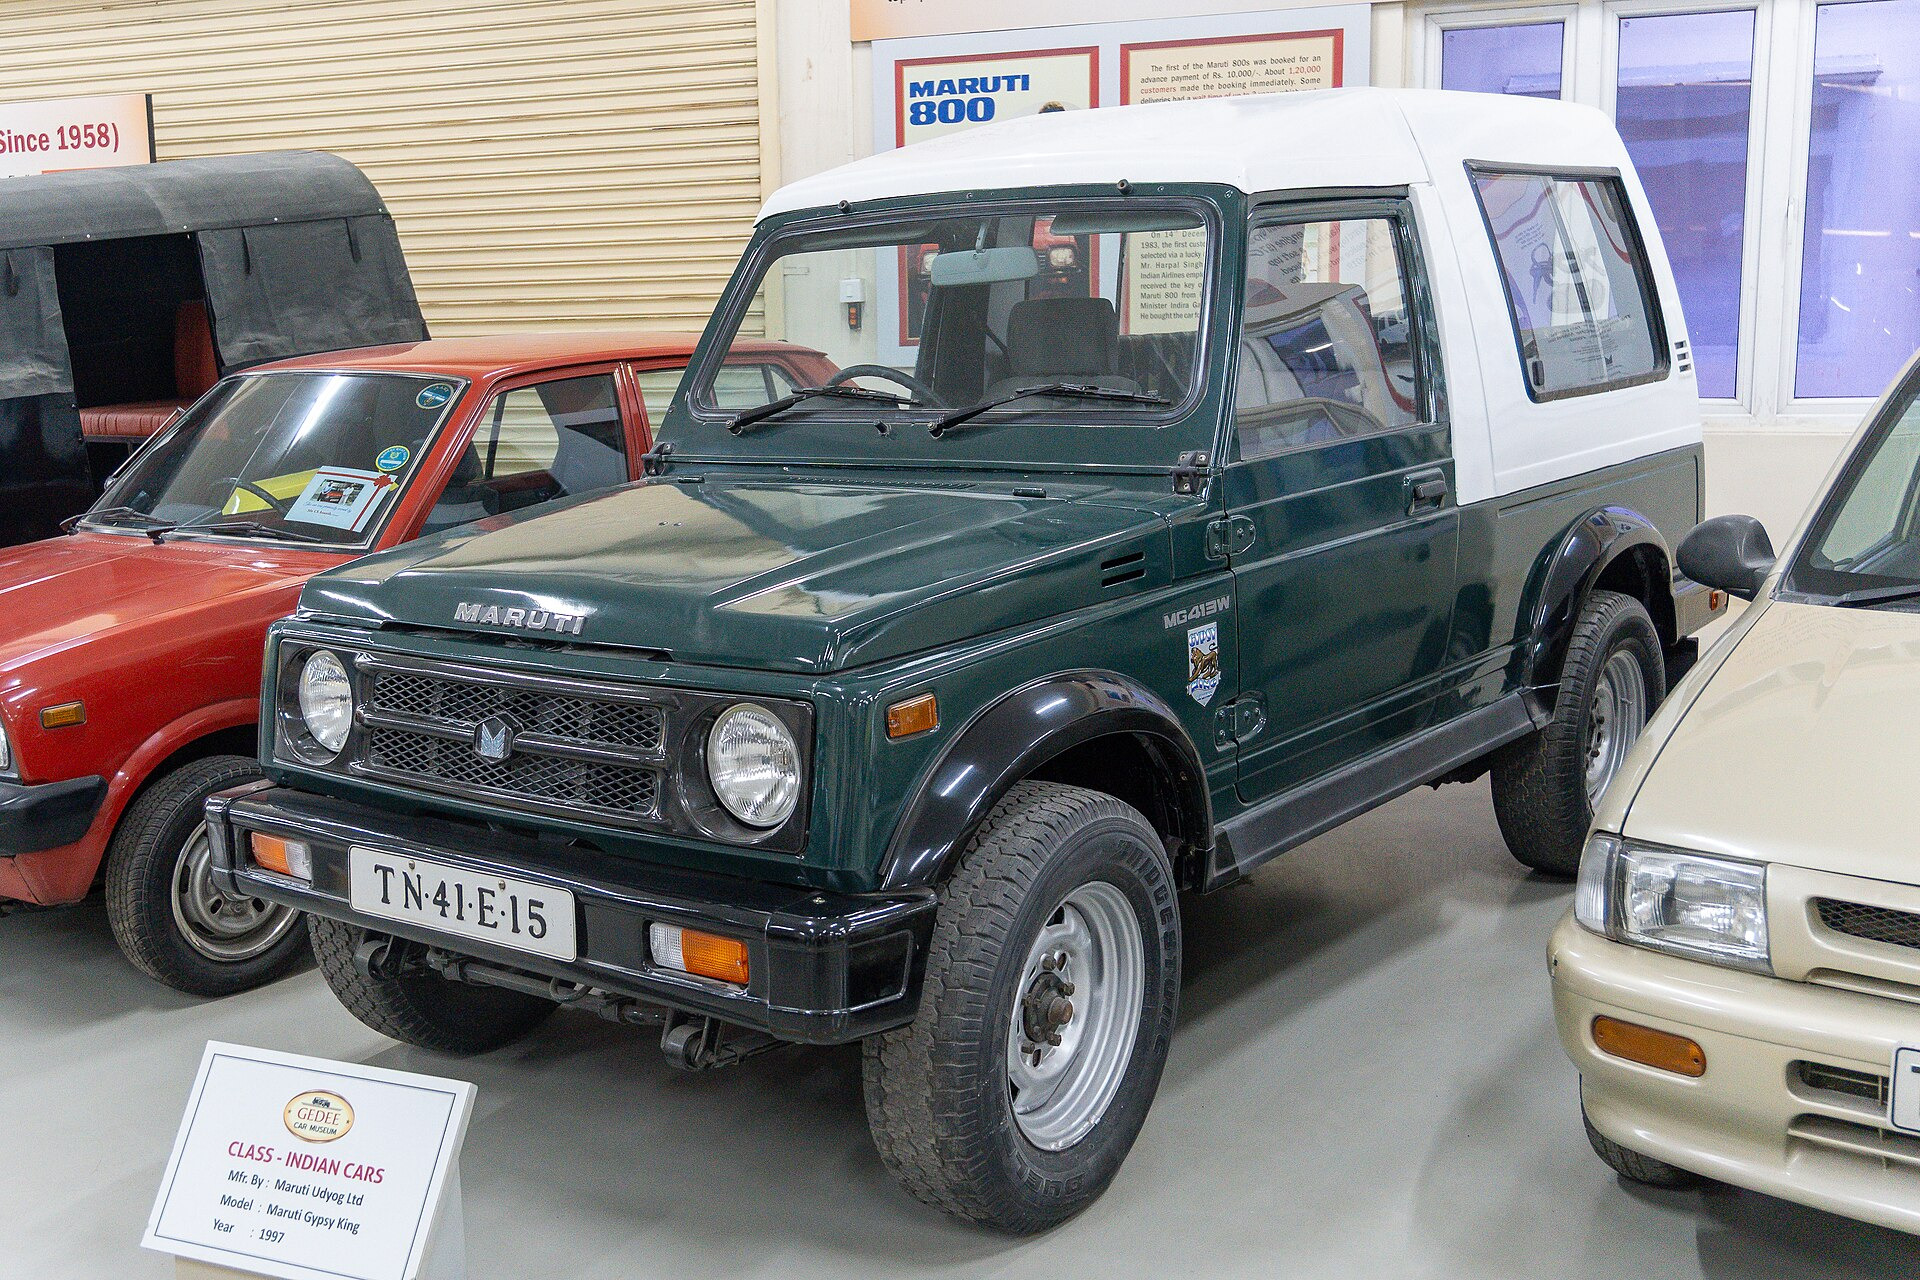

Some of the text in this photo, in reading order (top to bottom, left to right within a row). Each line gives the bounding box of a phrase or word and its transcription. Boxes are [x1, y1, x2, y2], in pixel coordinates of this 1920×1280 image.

[1140, 75, 1167, 84] advance
[1171, 73, 1199, 83] payment
[1265, 68, 1285, 76] About
[1289, 65, 1321, 75] 1,20,000
[1151, 64, 1162, 72] The
[1166, 64, 1179, 72] first
[1207, 60, 1228, 69] Maruti
[1270, 56, 1296, 65] booked
[910, 74, 1030, 98] MARUTI
[1140, 76, 1320, 94] customers made the booking immediately. Some
[910, 97, 995, 125] 800
[57, 122, 119, 152] 1958)
[1184, 262, 1203, 270] Singh
[1185, 251, 1200, 259] lucky
[1150, 312, 1172, 321] bought
[454, 602, 588, 635] MARUTI
[1163, 595, 1230, 630] MG413W
[1188, 626, 1217, 648] GYPSY
[297, 1107, 342, 1126] GEDEE
[293, 1122, 337, 1136] CAR MUSEUM
[228, 1141, 274, 1163] CLASS
[285, 1152, 341, 1176] INDIAN
[343, 1162, 385, 1184] CARS
[228, 1170, 248, 1184] Mfr.
[251, 1174, 264, 1189] By
[274, 1179, 310, 1196] Maruti
[312, 1187, 345, 1206] Udyog
[346, 1193, 364, 1206] Ltd
[220, 1194, 254, 1211] Model
[266, 1204, 302, 1220] Maruti
[304, 1211, 335, 1230] Gypsy
[337, 1218, 360, 1235] King
[212, 1218, 234, 1234] Year
[258, 1228, 285, 1244] 1997
